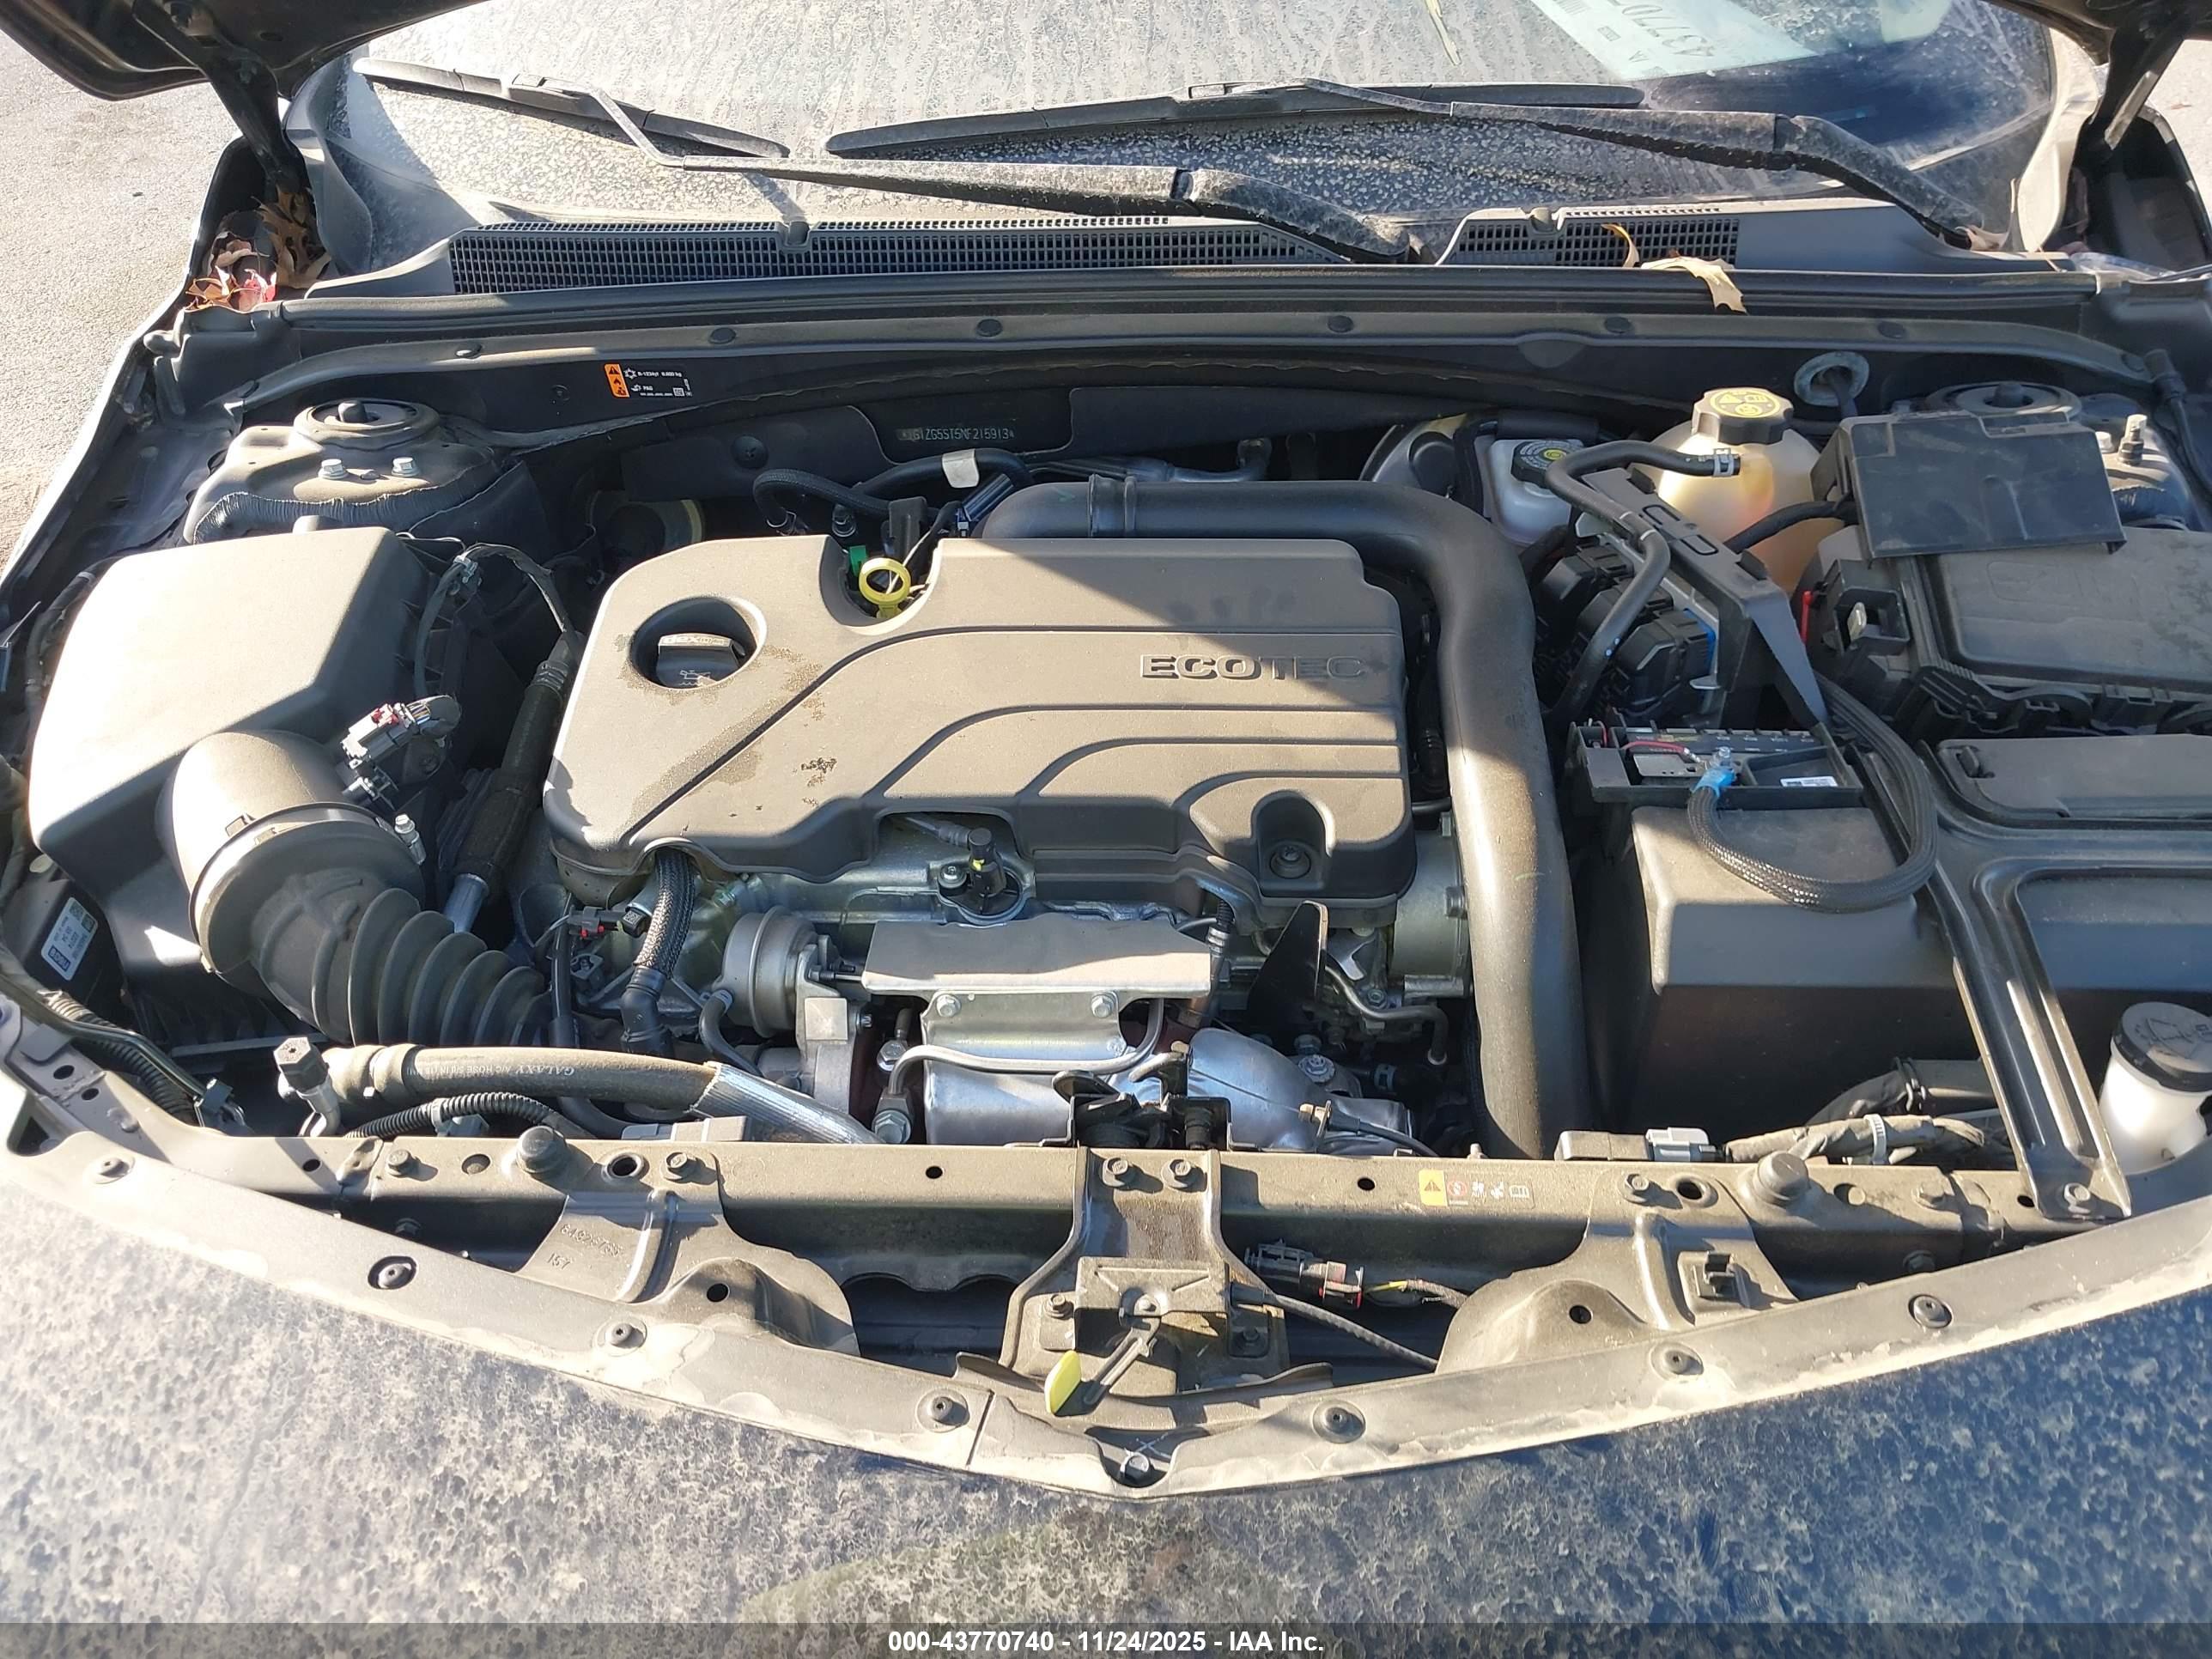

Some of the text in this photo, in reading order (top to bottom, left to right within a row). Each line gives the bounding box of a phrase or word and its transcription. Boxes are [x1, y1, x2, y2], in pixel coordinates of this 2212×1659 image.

[1140, 654, 1365, 680] ECOTEC
[466, 1065, 494, 1074] HOSE
[515, 1065, 574, 1076] GALAXY
